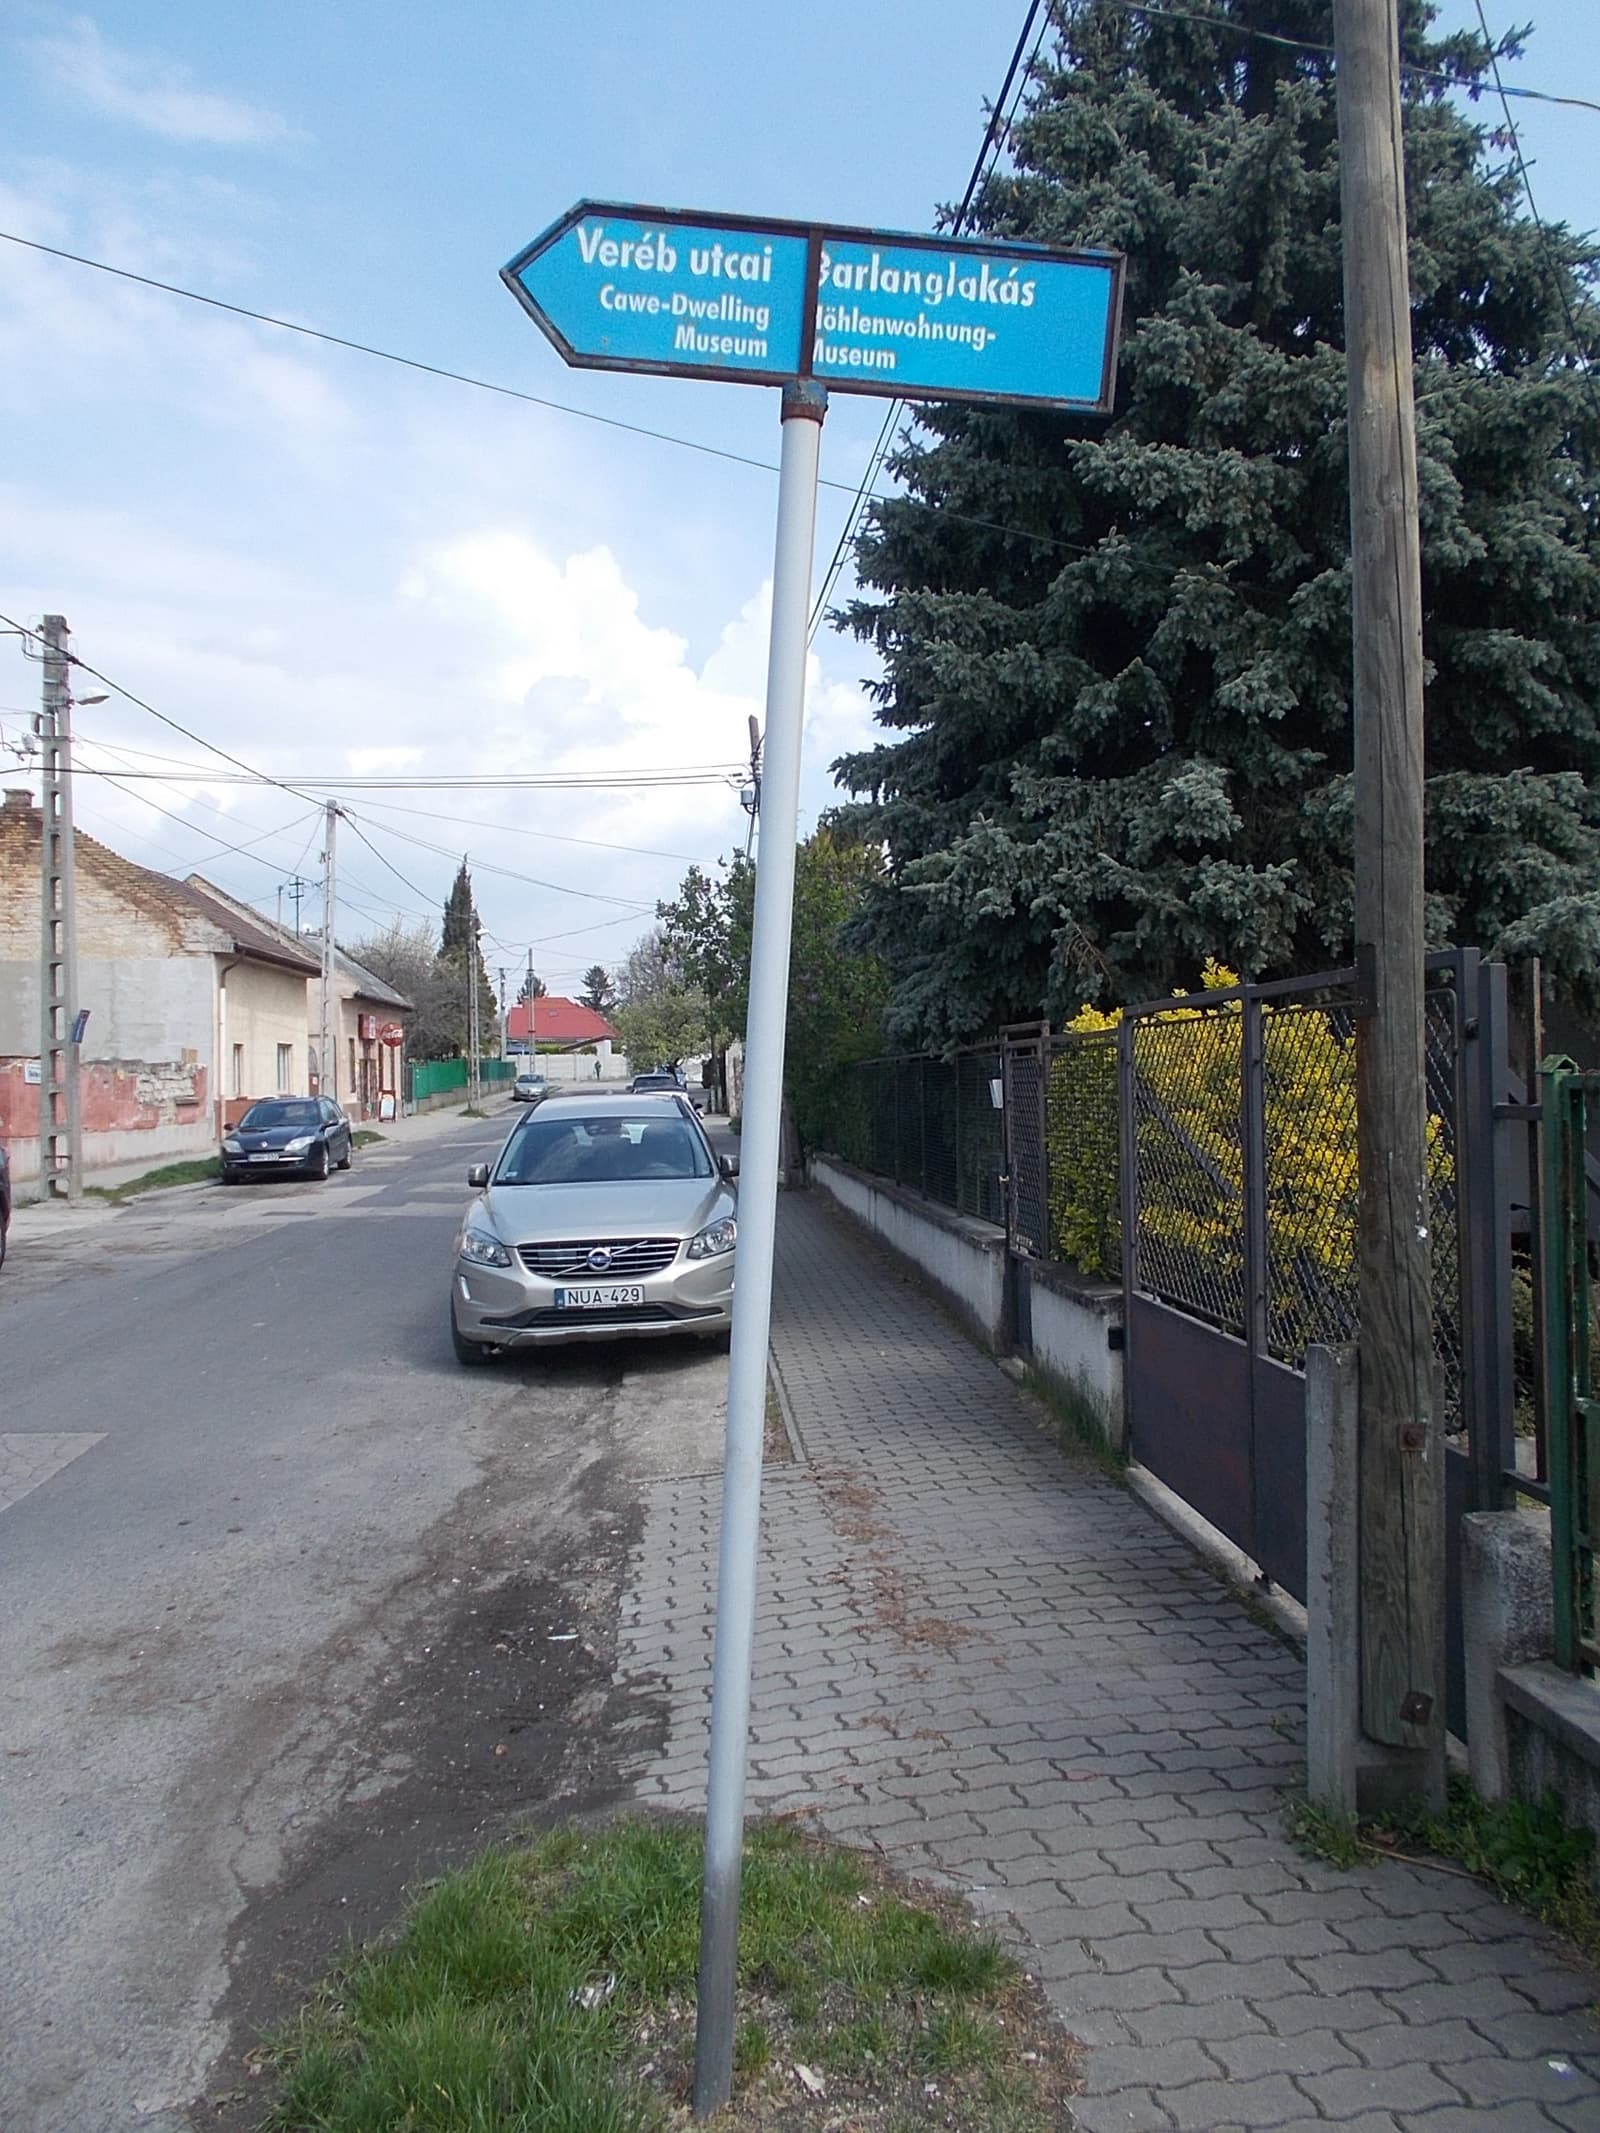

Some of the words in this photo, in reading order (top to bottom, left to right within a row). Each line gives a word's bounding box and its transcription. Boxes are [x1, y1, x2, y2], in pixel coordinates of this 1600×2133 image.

[576, 225, 677, 273] Veréb
[690, 243, 772, 282] utcai
[600, 284, 770, 331] Cawe-Dwelling
[674, 325, 768, 357] Museum
[568, 1288, 639, 1304] NUA-429
